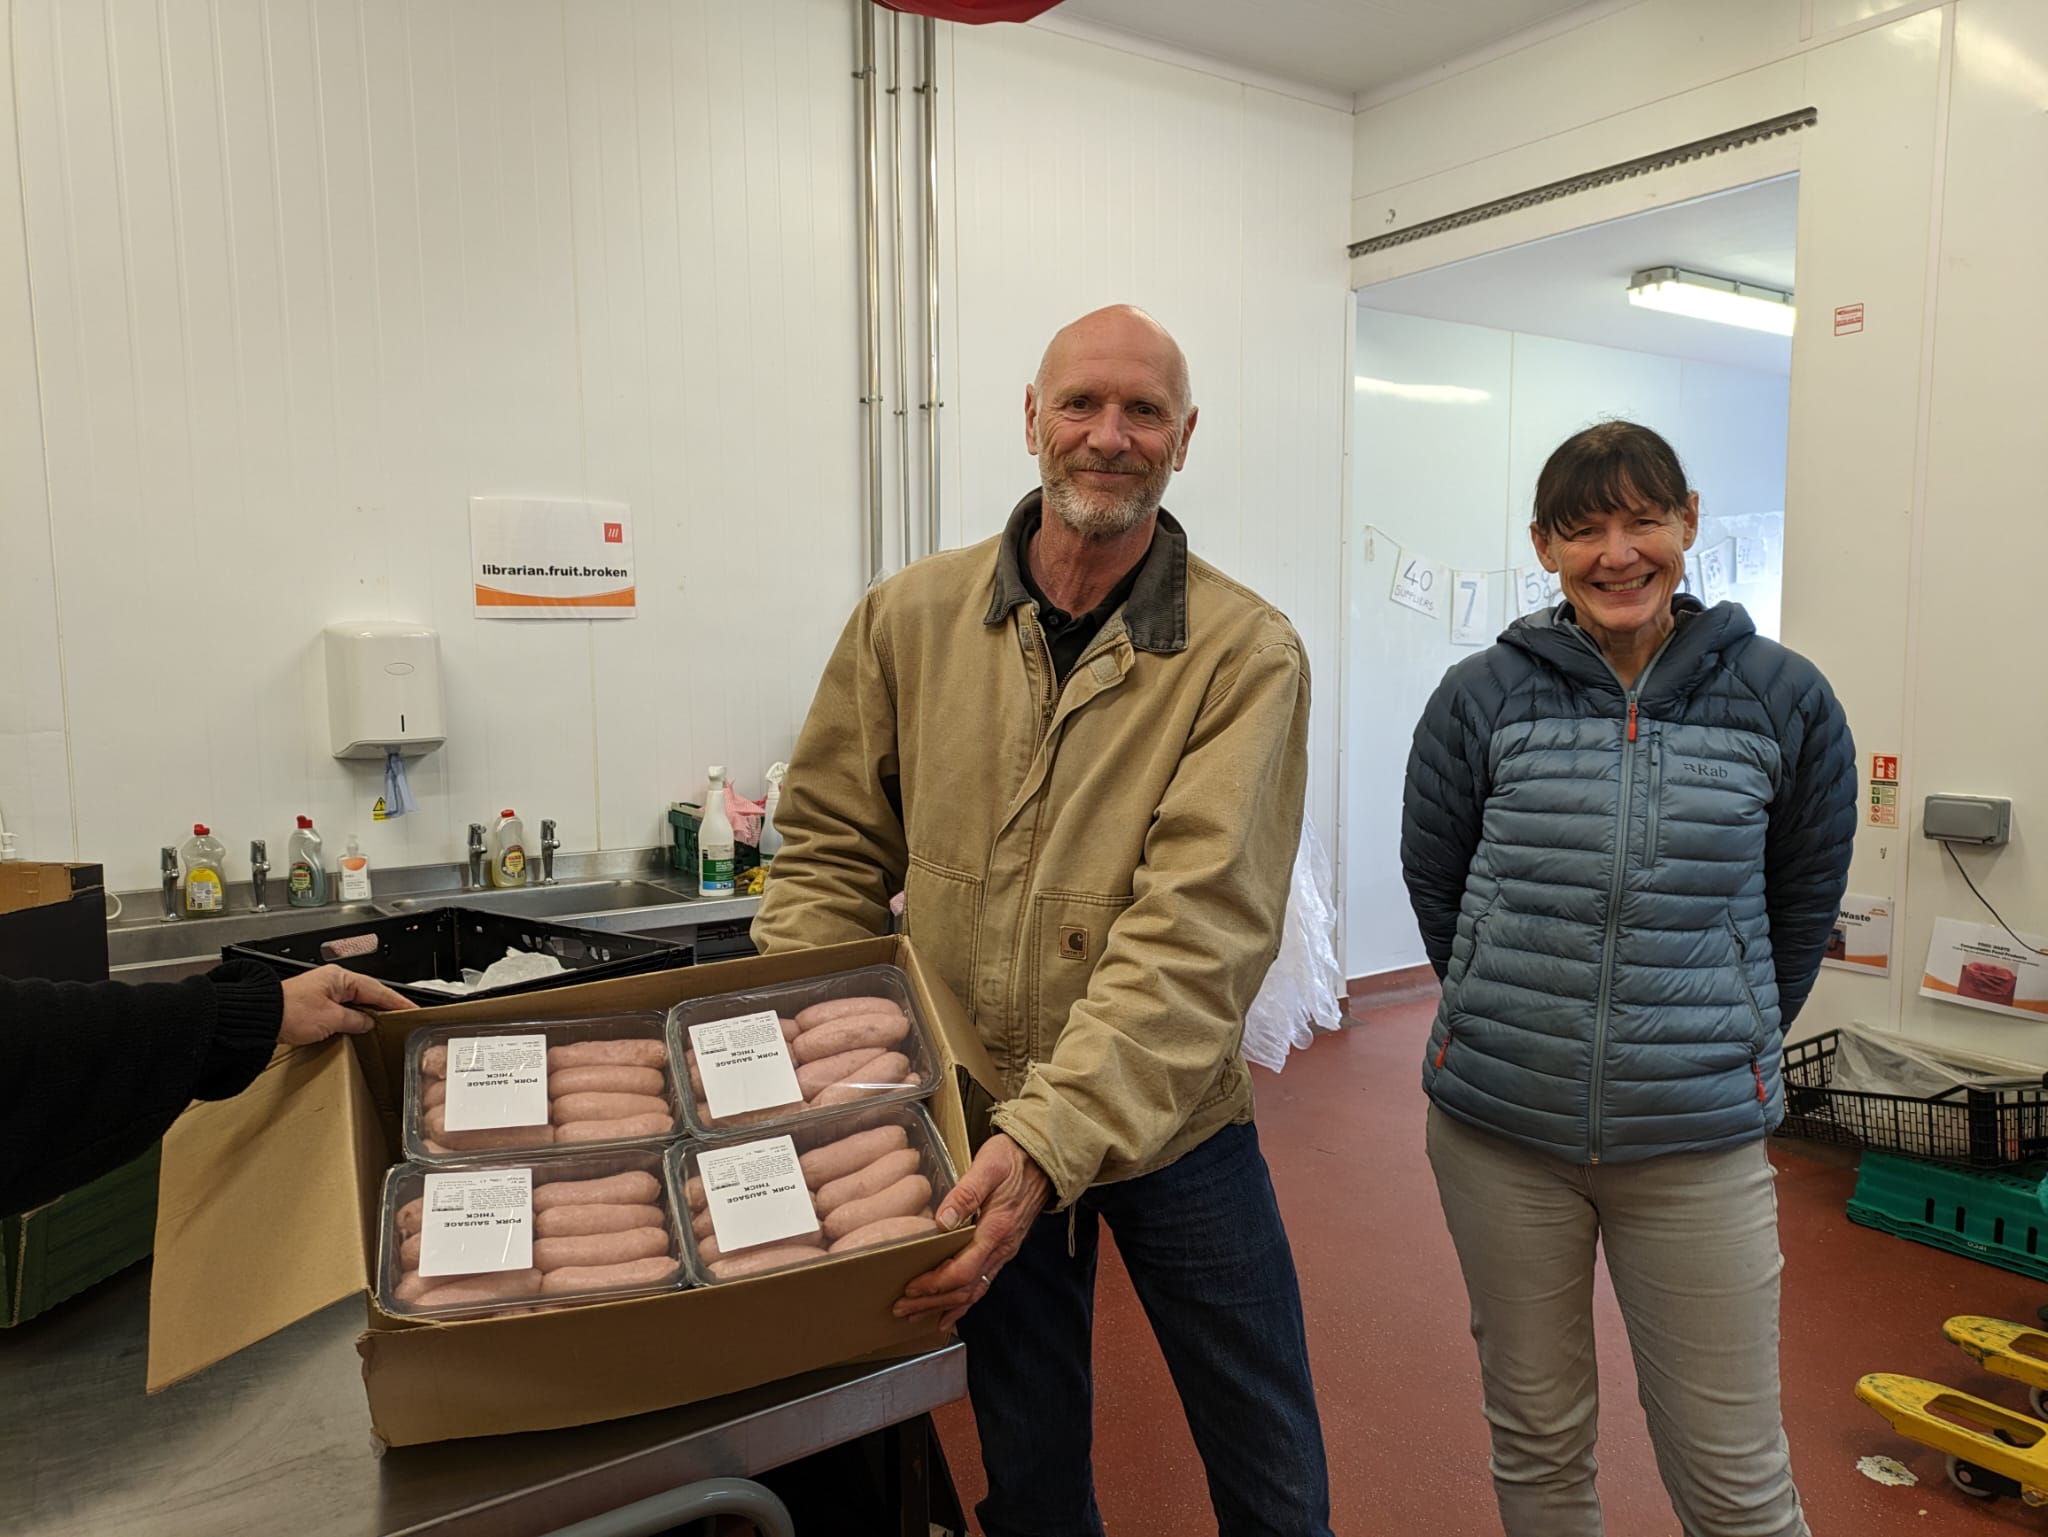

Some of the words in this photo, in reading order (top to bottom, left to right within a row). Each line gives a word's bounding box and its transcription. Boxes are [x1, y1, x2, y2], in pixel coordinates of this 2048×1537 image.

[482, 564, 628, 578] librarian.fruit.broken
[1403, 560, 1433, 592] 40
[1460, 581, 1477, 627] 7
[1697, 763, 1728, 778] Rab
[1840, 911, 1871, 922] Waste
[731, 1048, 755, 1057] THICK
[757, 1051, 779, 1059] PORK
[715, 1056, 753, 1068] SAUSAGE
[467, 1079, 509, 1087] SAUSAGE
[744, 1182, 770, 1192] THICK
[772, 1184, 796, 1194] PORK
[727, 1191, 767, 1204] SAUSAGE
[444, 1220, 490, 1228] SAUSAGE
